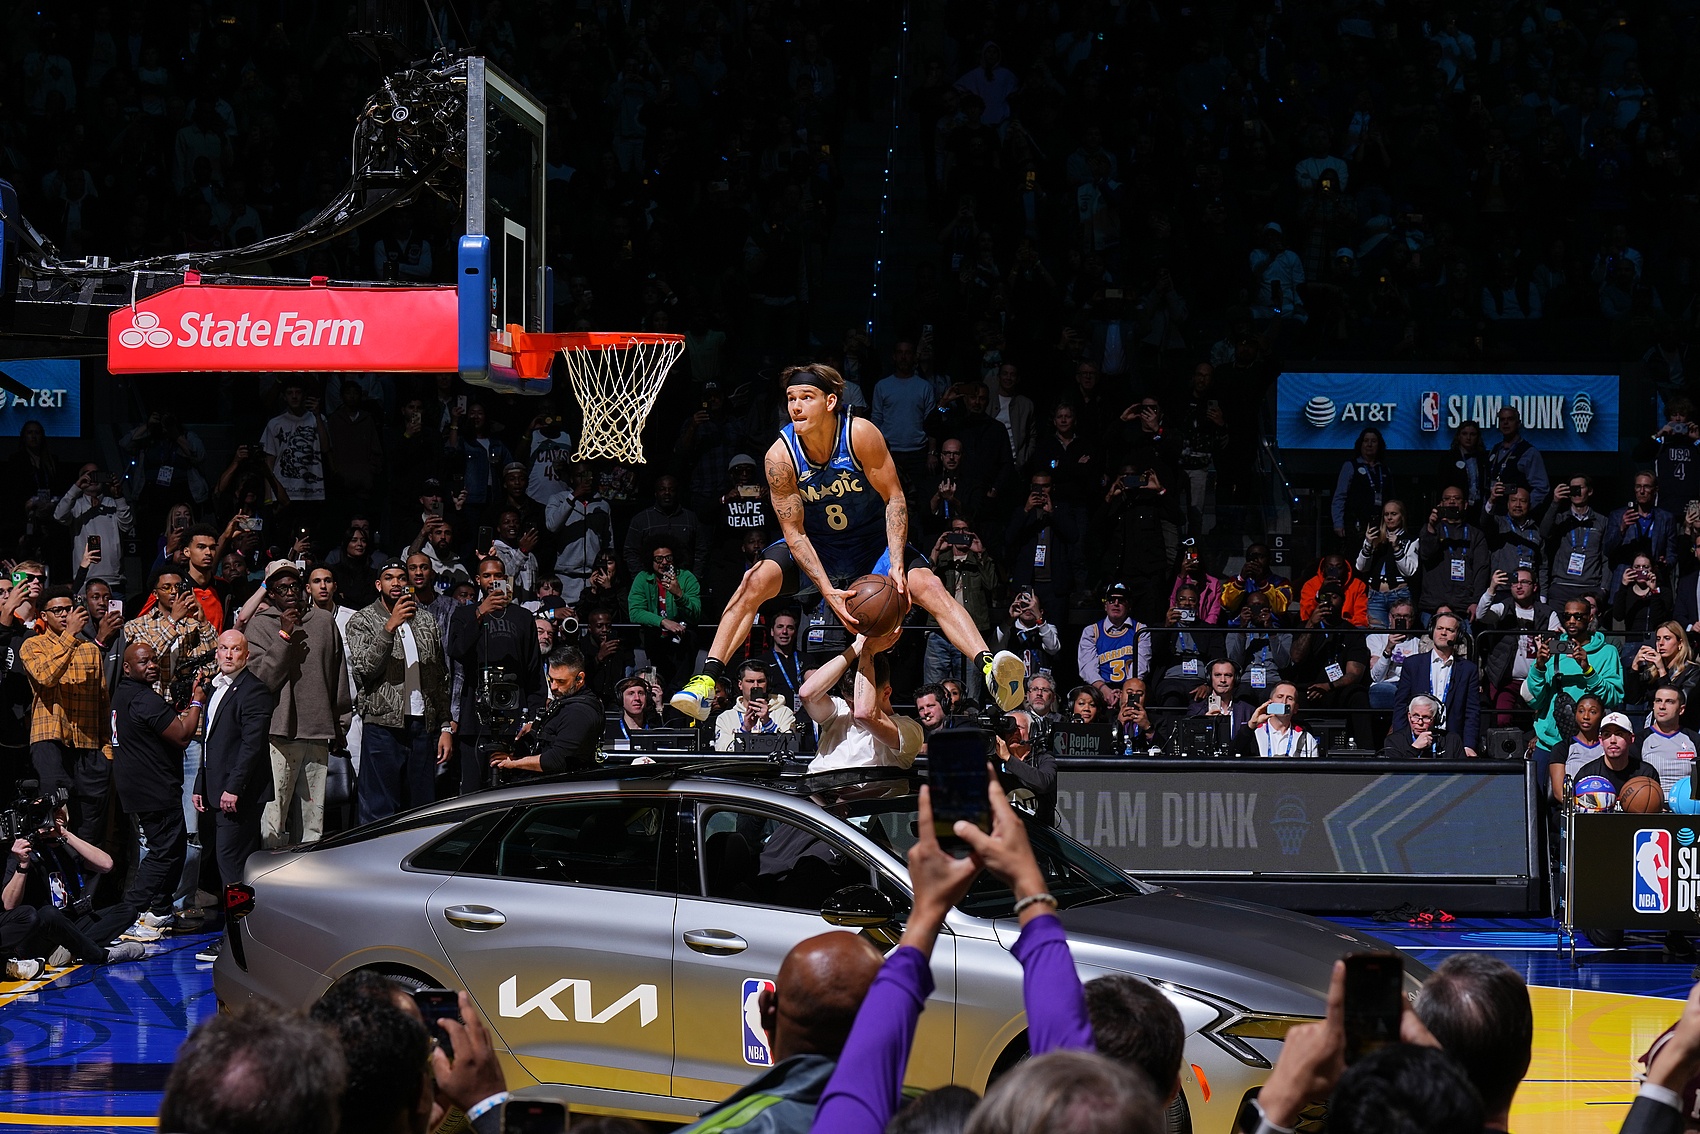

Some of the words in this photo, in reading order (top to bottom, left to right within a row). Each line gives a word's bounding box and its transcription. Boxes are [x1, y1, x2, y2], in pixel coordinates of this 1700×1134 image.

[177, 311, 272, 348] State
[273, 311, 365, 347] Farm
[11, 388, 67, 408] AT&T
[1341, 402, 1397, 422] AT&T
[1669, 447, 1691, 461] USA
[1673, 462, 1685, 481] 4
[727, 513, 765, 528] DEALER
[824, 503, 849, 531] 8
[128, 542, 137, 554] 3
[1275, 536, 1284, 548] 6
[1275, 552, 1284, 563] 5
[1069, 732, 1100, 751] Replay
[1055, 790, 1147, 848] SLAM
[1161, 791, 1259, 848] DUNK
[1638, 893, 1657, 908] NBA
[747, 1045, 765, 1061] NBA
